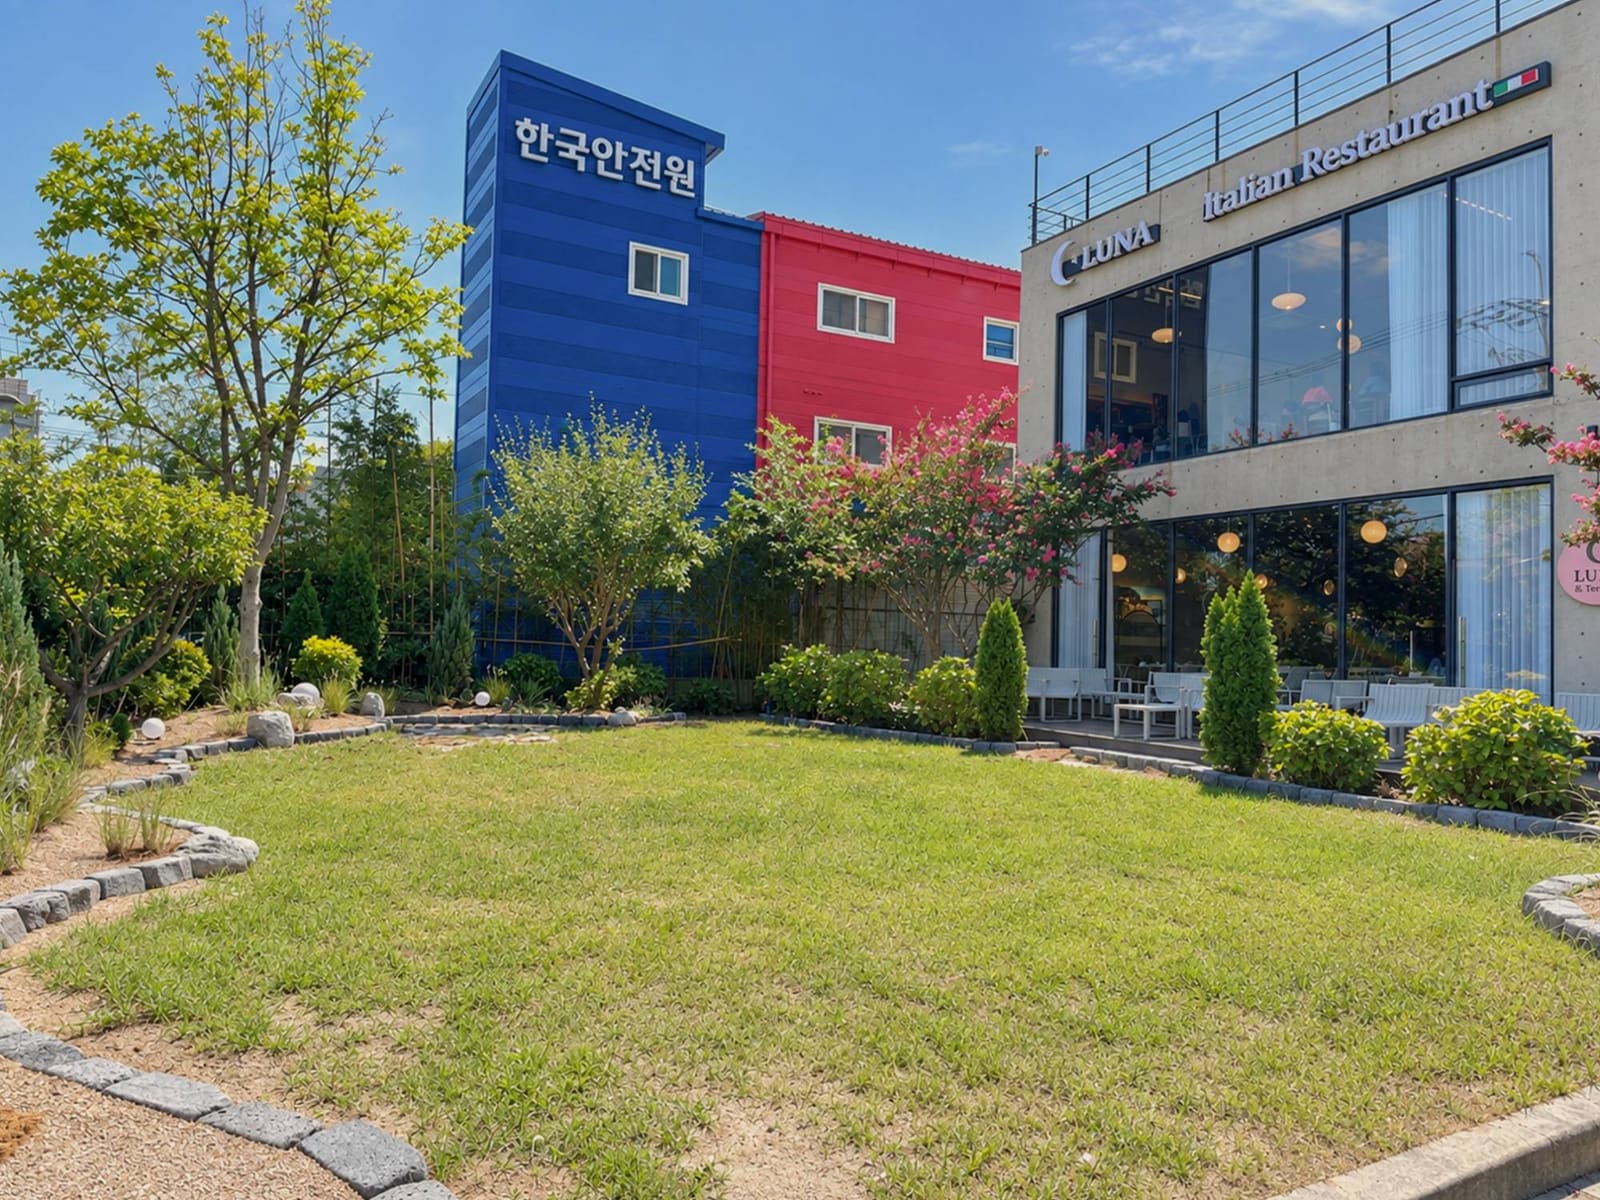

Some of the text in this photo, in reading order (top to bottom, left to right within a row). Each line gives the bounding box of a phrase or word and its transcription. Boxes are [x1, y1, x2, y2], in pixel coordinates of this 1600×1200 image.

[514, 117, 696, 199] 한국안전원
[1203, 79, 1494, 221] Italian Restaurant
[1081, 219, 1154, 270] LUNA
[1574, 569, 1600, 583] LU
